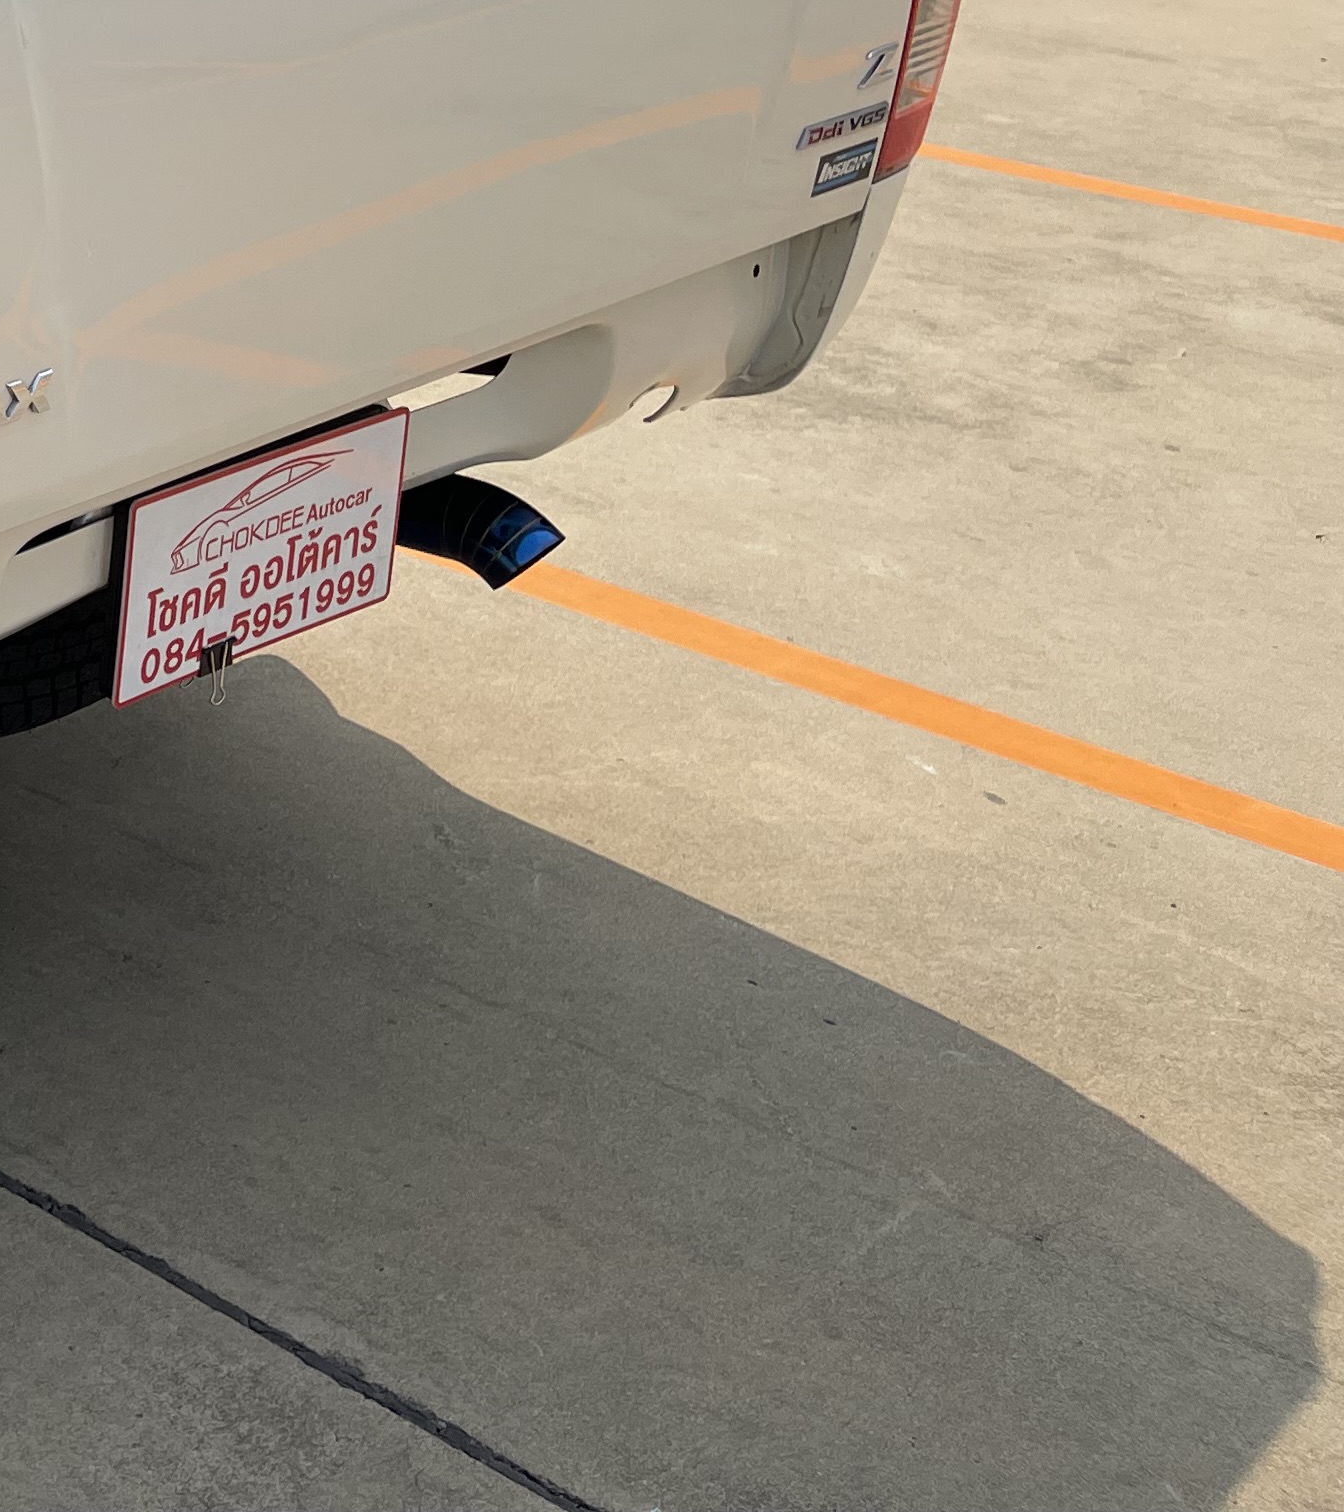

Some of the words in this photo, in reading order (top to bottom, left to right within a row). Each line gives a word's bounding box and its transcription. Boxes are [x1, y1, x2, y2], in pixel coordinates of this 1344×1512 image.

[808, 119, 845, 146] Ddi
[850, 105, 888, 132] VGS
[147, 561, 229, 639] โชคดี
[240, 504, 383, 600] ออโต้คาร์
[205, 506, 305, 563] CHOKDEE
[306, 487, 373, 525] Autocar
[140, 562, 376, 684] 084-5951999
